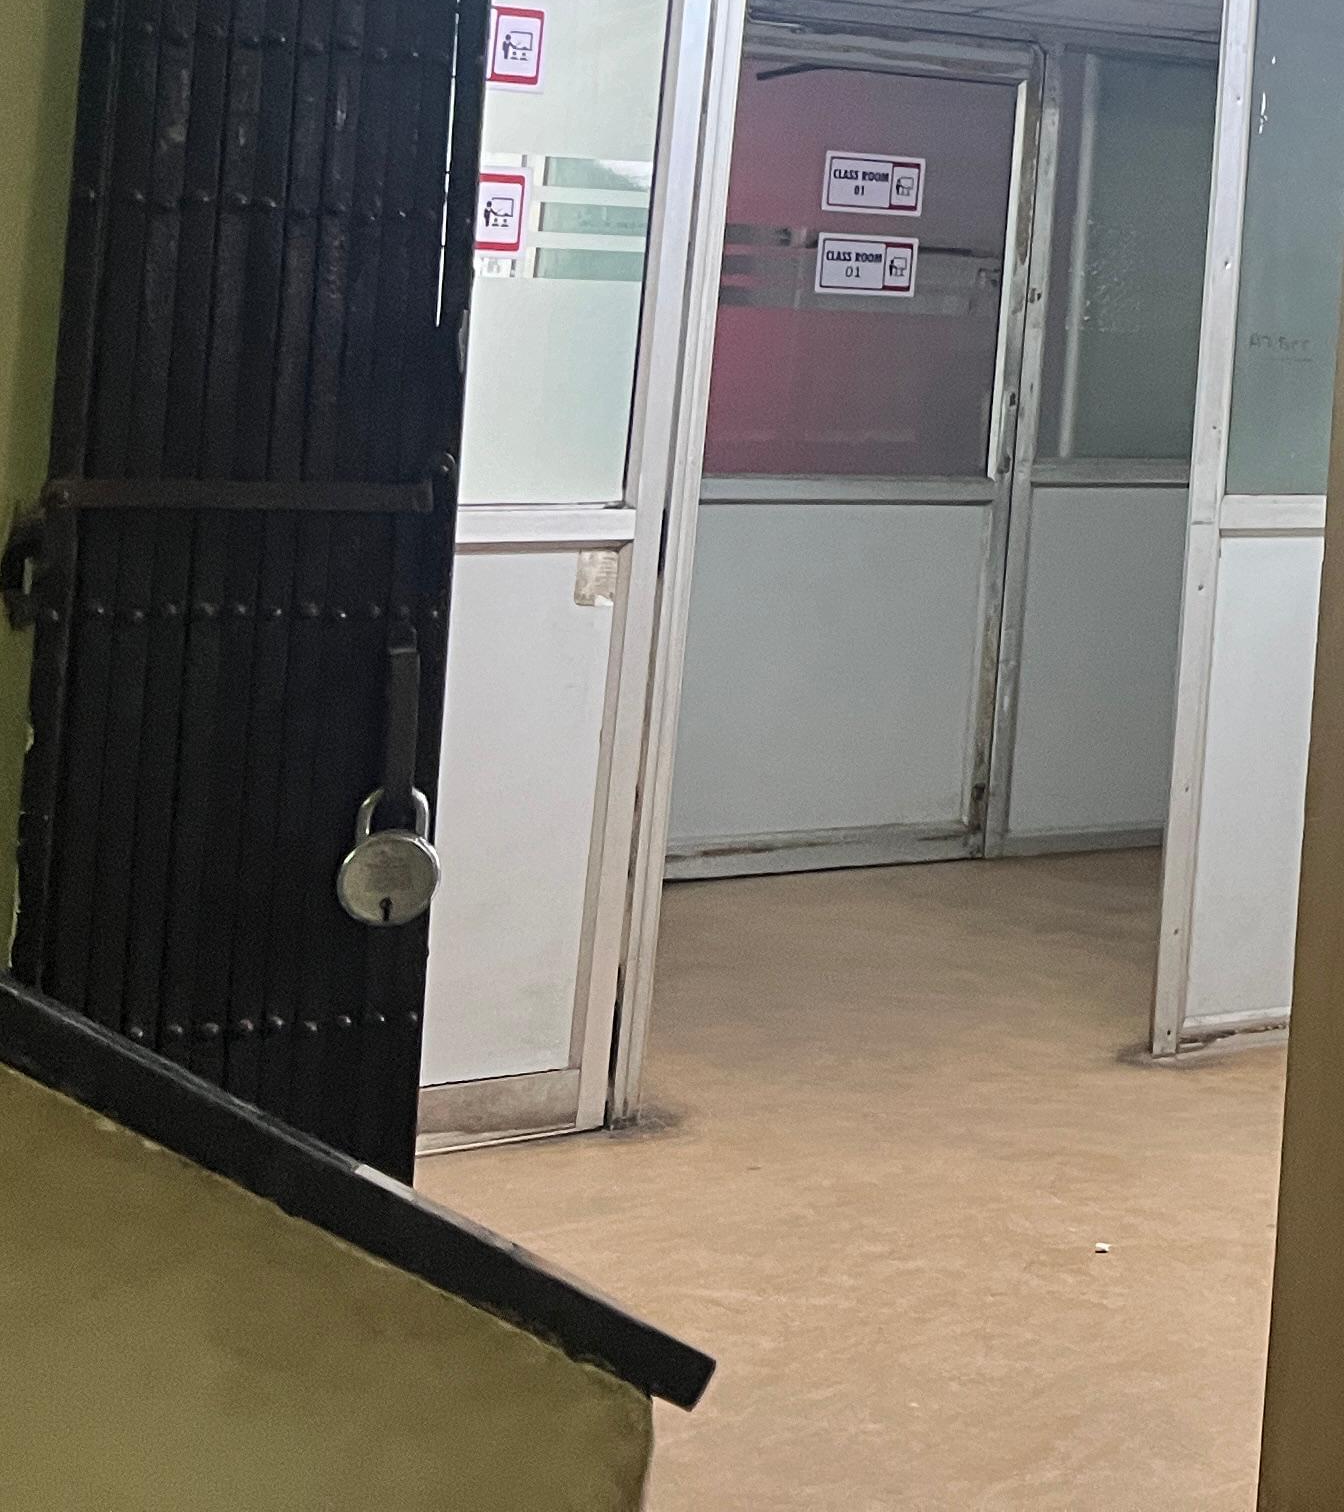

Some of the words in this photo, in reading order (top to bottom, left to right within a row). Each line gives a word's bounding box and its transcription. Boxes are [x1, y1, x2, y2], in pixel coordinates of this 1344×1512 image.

[833, 169, 858, 181] CLASS
[862, 171, 889, 182] ROOM
[854, 185, 865, 196] 01
[826, 250, 851, 262] CLASS
[855, 252, 882, 263] ROOM
[845, 267, 860, 278] 01
